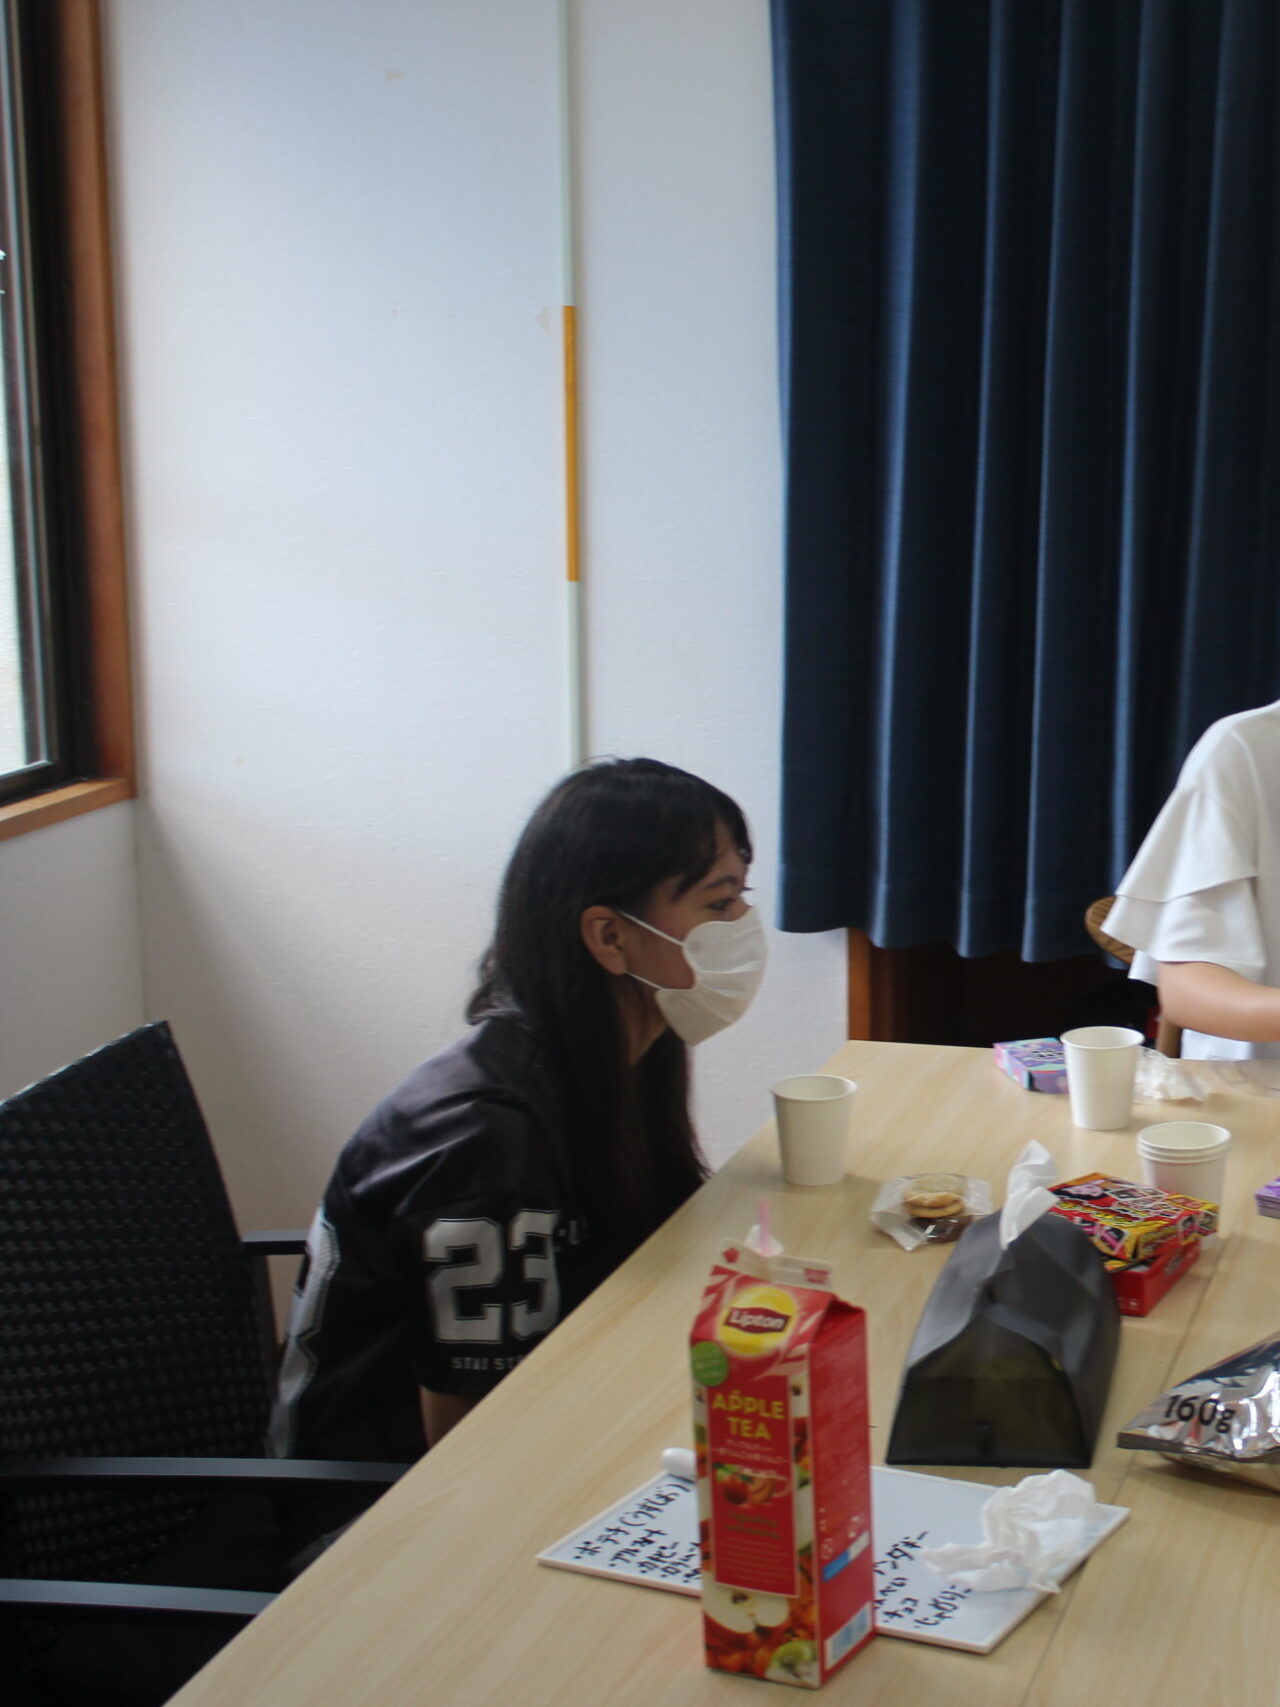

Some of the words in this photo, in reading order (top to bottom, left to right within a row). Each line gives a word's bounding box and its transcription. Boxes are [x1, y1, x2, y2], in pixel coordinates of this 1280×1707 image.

[422, 1208, 561, 1344] 23
[729, 1309, 786, 1329] Lipton
[712, 1390, 785, 1420] APPLE
[1164, 1394, 1236, 1434] 160g
[725, 1416, 773, 1441] TEA
